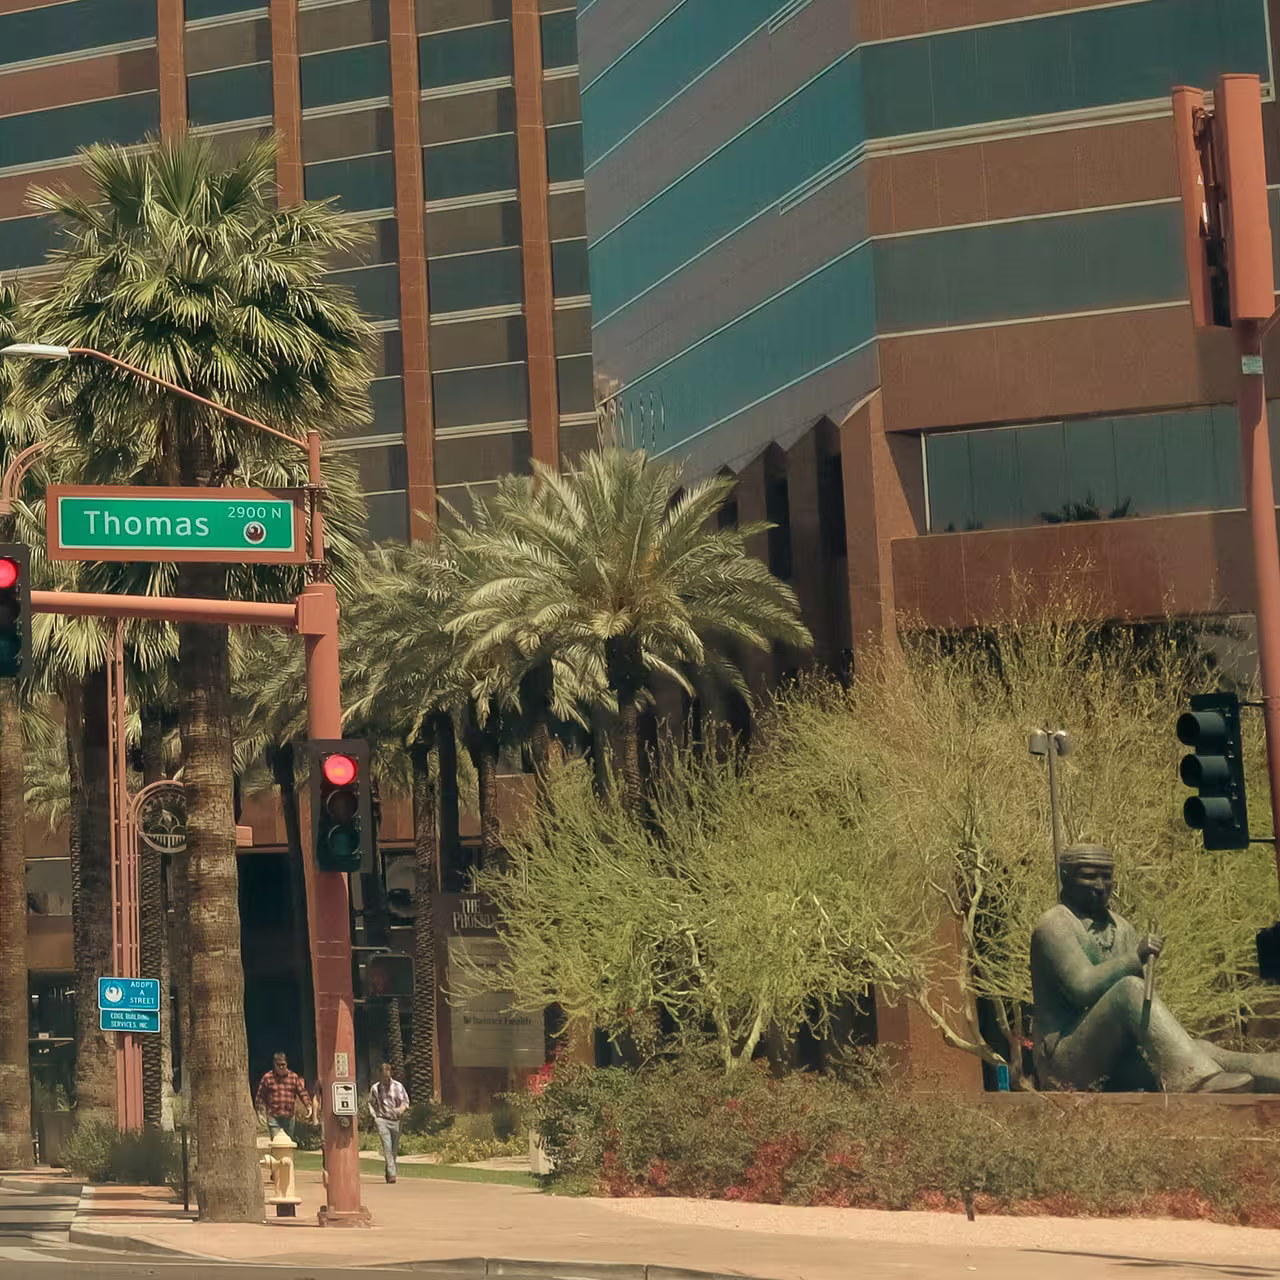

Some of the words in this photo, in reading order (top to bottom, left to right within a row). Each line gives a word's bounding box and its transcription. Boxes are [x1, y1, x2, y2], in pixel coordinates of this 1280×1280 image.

[83, 510, 209, 536] Thomas
[227, 506, 266, 519] 2900
[271, 507, 282, 519] N
[459, 899, 481, 914] THE
[129, 997, 155, 1005] STREET
